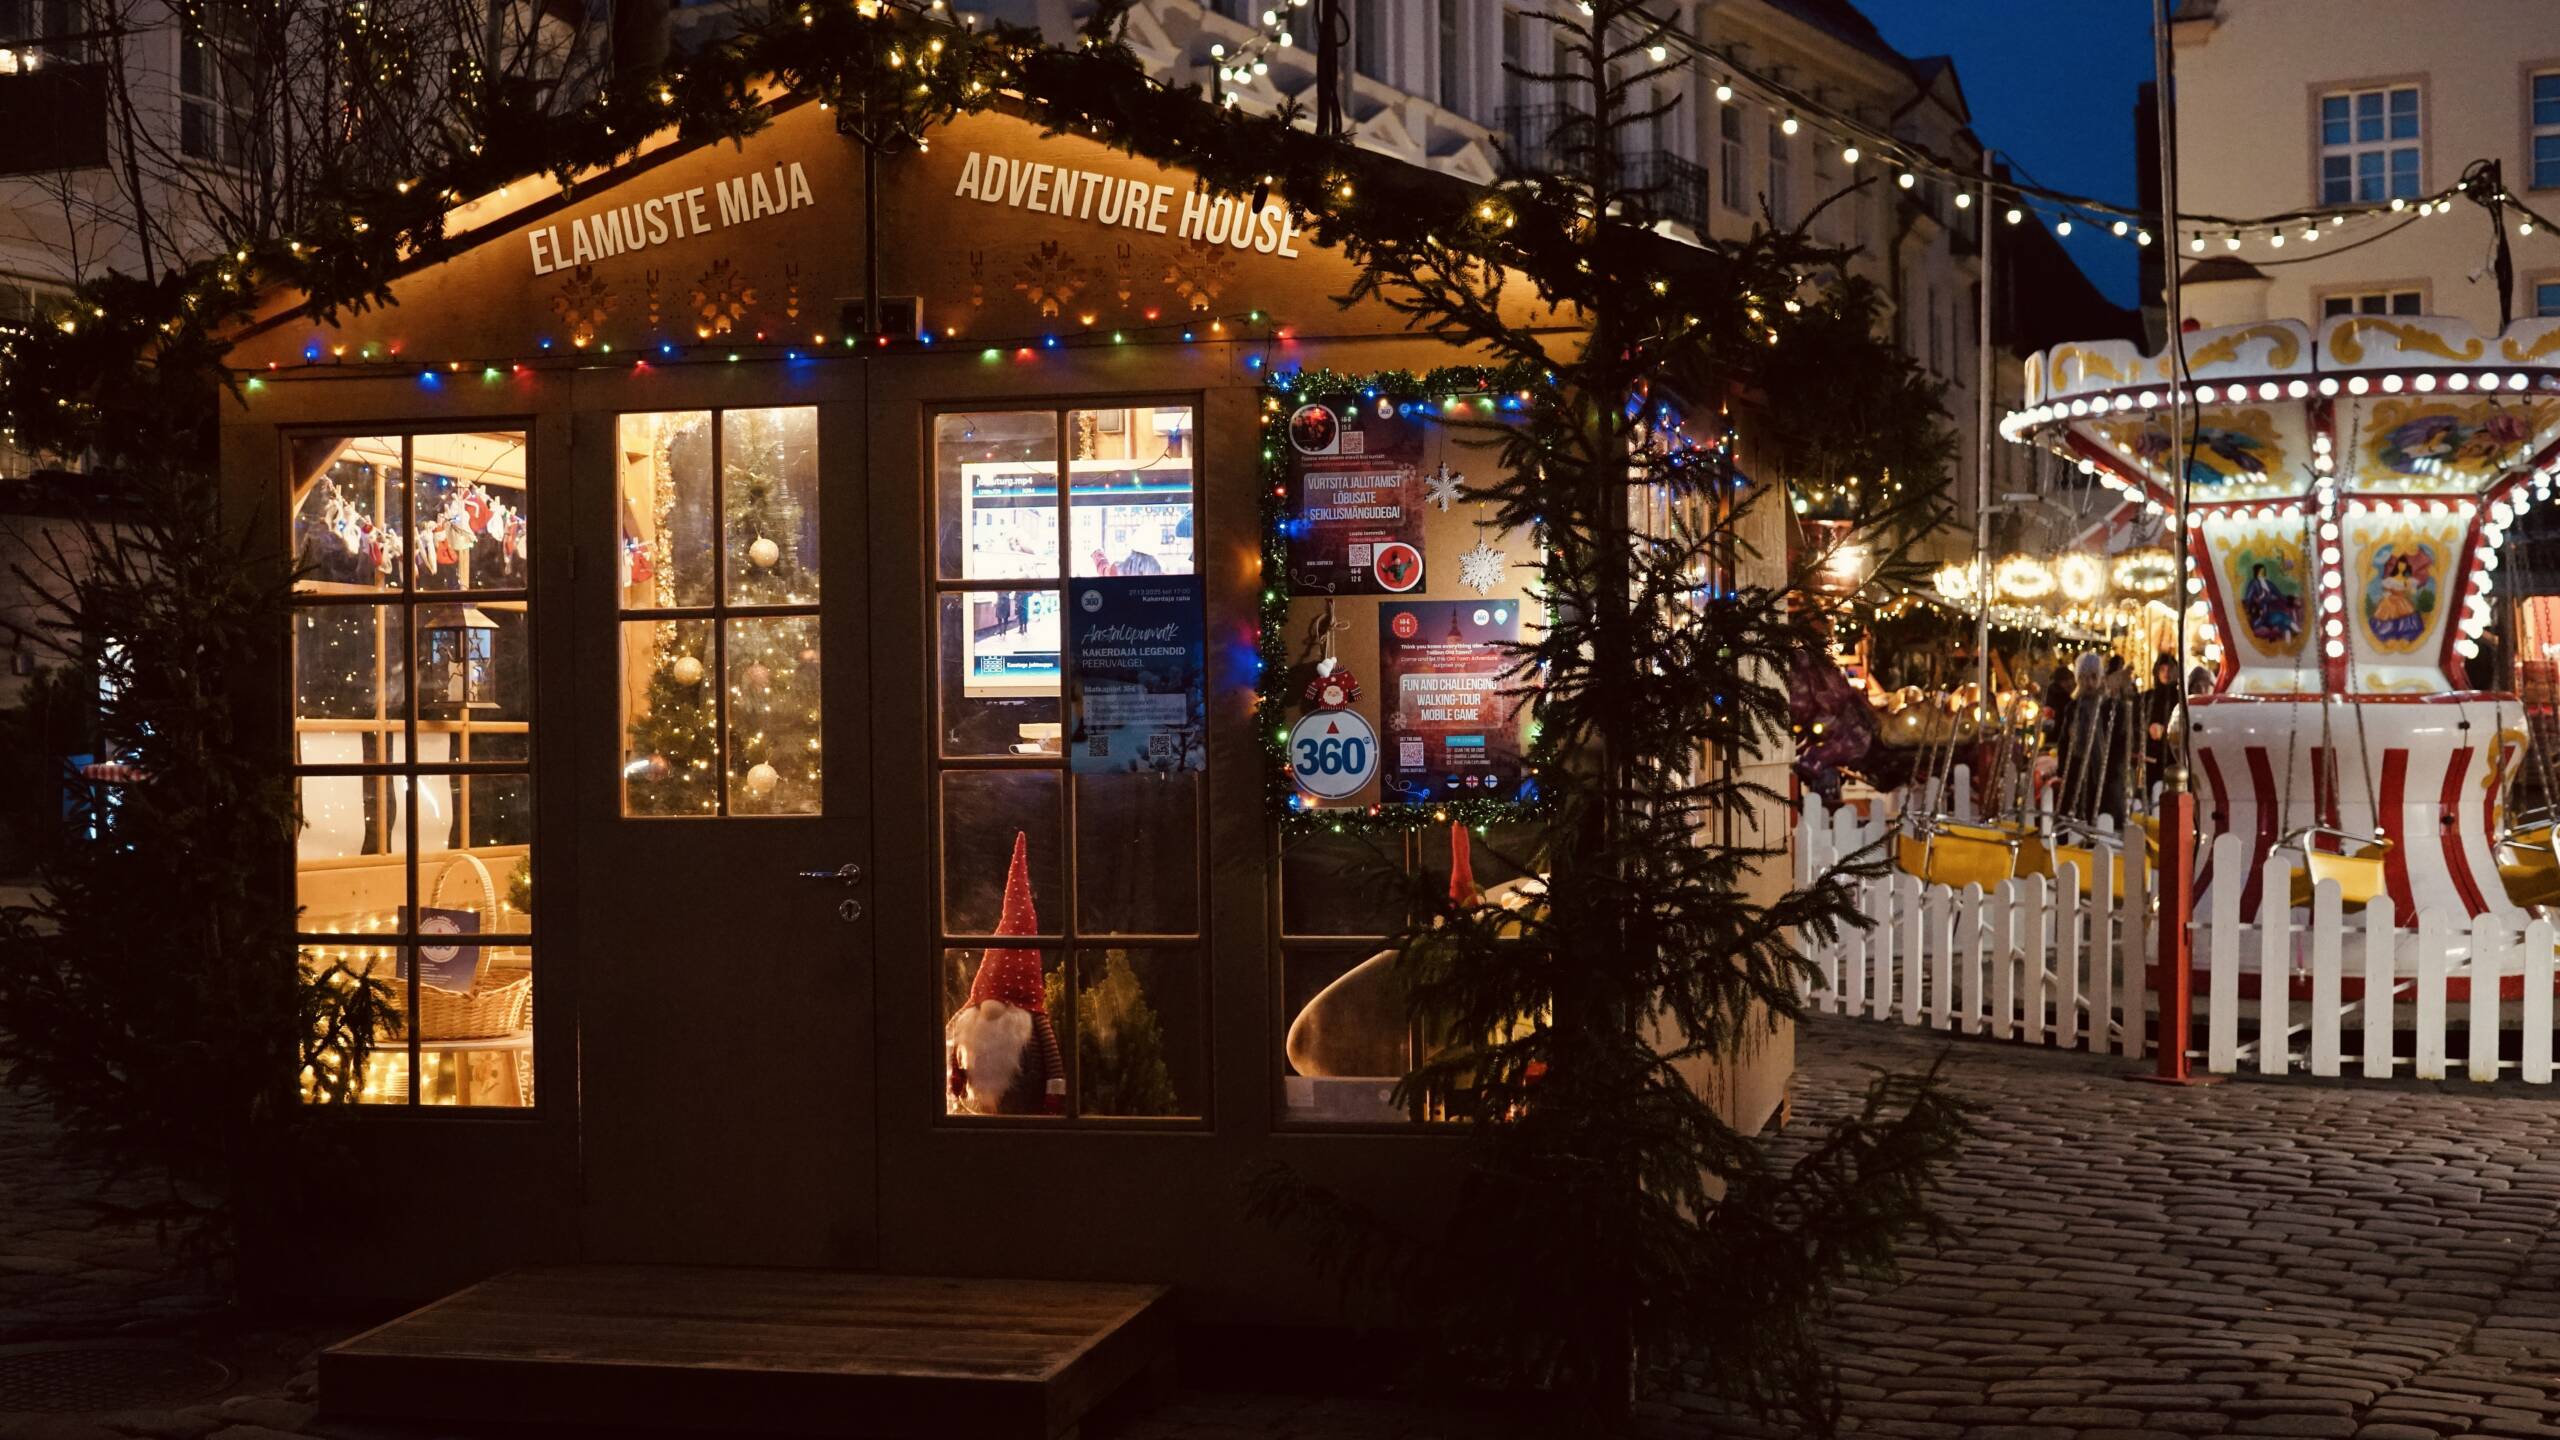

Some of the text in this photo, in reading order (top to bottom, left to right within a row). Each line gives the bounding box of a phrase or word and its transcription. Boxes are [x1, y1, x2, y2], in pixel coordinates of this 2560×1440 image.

[955, 151, 1301, 259] ADVENTURE HOUSE
[528, 161, 815, 276] ELAMUSTE MAJA
[1350, 475, 1401, 489] JALUTAMIST
[1333, 490, 1376, 504] LÕBUSATE
[1082, 647, 1186, 657] KAKERDAJA LEGENDID
[1082, 659, 1144, 668] PEERUVALGEL
[1403, 678, 1497, 691] FUN AND CHALLENGING
[1417, 693, 1481, 706] WALKING-TOUR
[1421, 708, 1479, 720] MOBILE GAME
